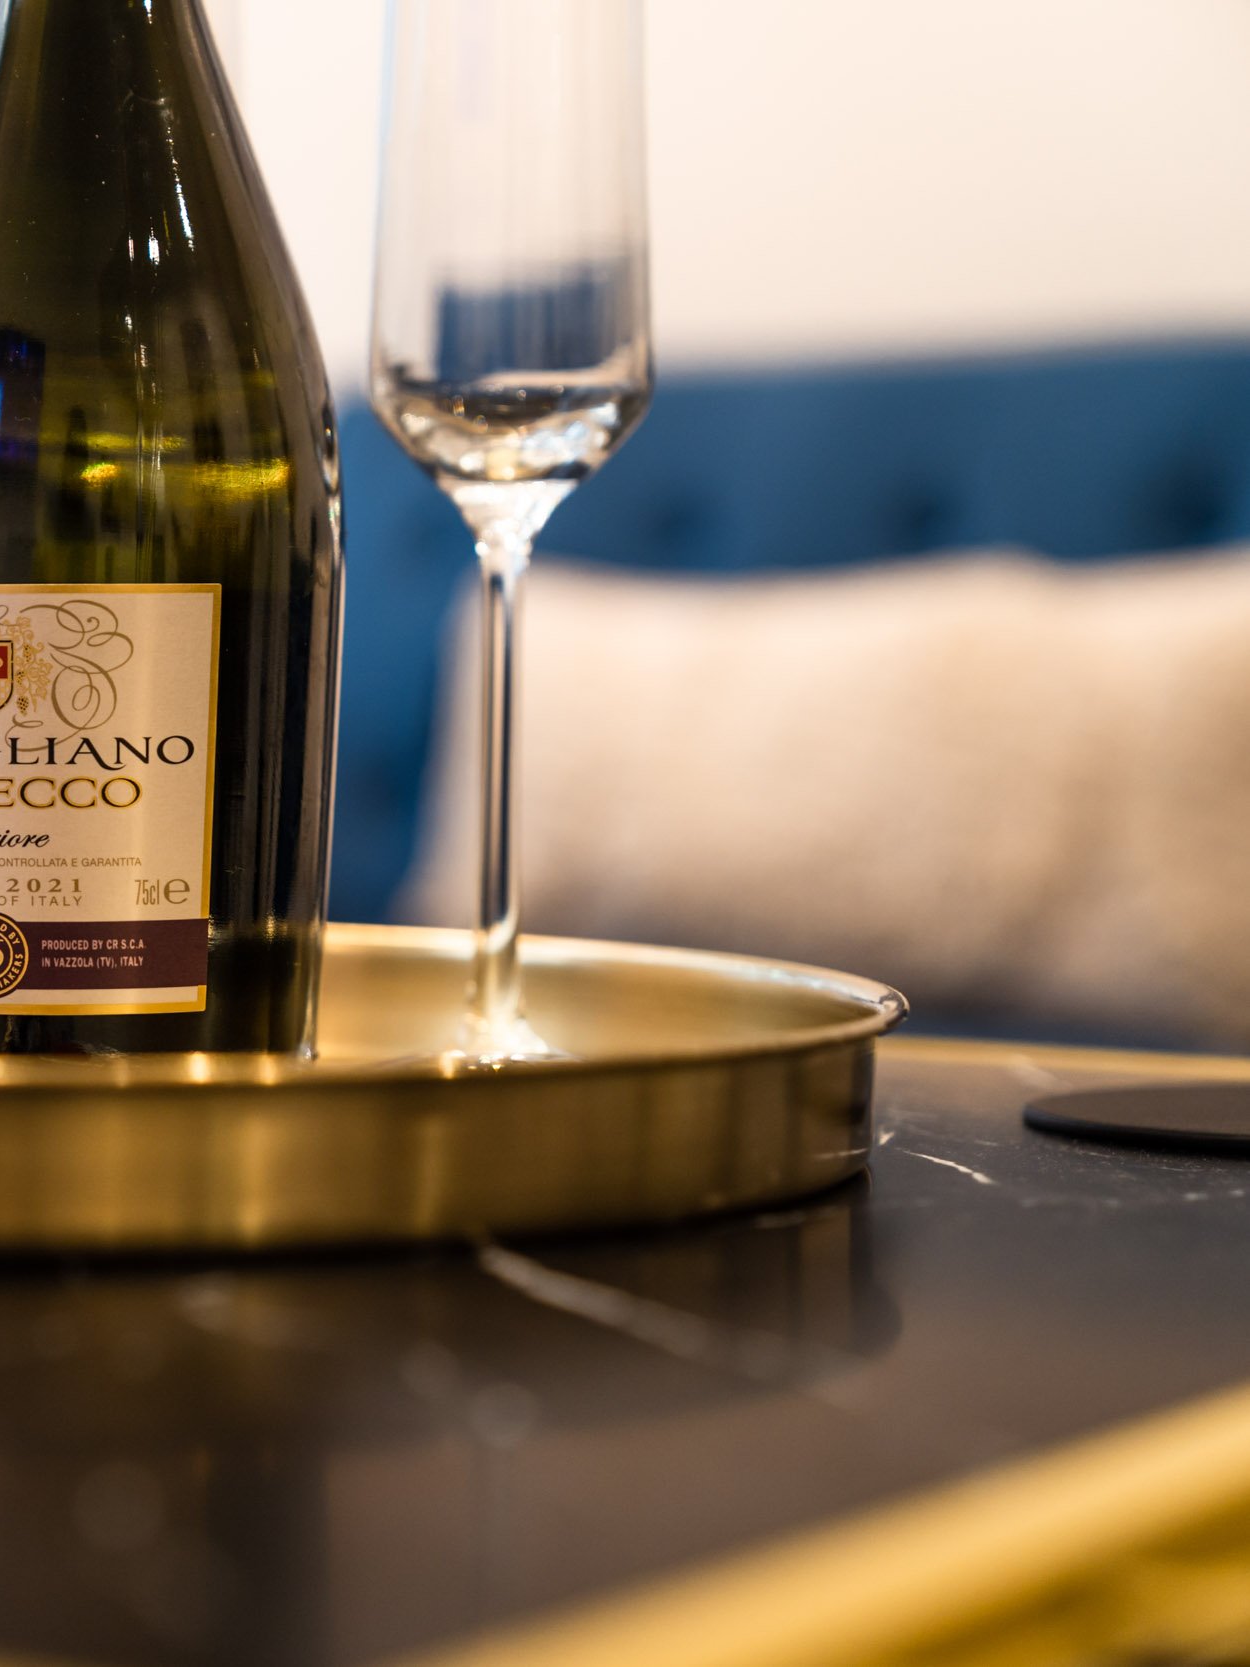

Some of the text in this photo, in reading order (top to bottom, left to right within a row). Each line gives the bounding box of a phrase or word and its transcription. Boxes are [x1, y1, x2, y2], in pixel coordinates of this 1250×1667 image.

[71, 858, 78, 868] E
[81, 857, 142, 868] GARANTITA
[6, 878, 82, 893] 2021
[134, 879, 160, 906] 75cl
[31, 895, 83, 907] ITALY
[8, 931, 21, 945] BY
[41, 939, 90, 950] PRODUCED
[92, 940, 103, 950] BY
[106, 939, 118, 950] CR
[41, 957, 51, 967] IN
[53, 956, 94, 968] VAZZOLA
[120, 956, 144, 967] ITALY
